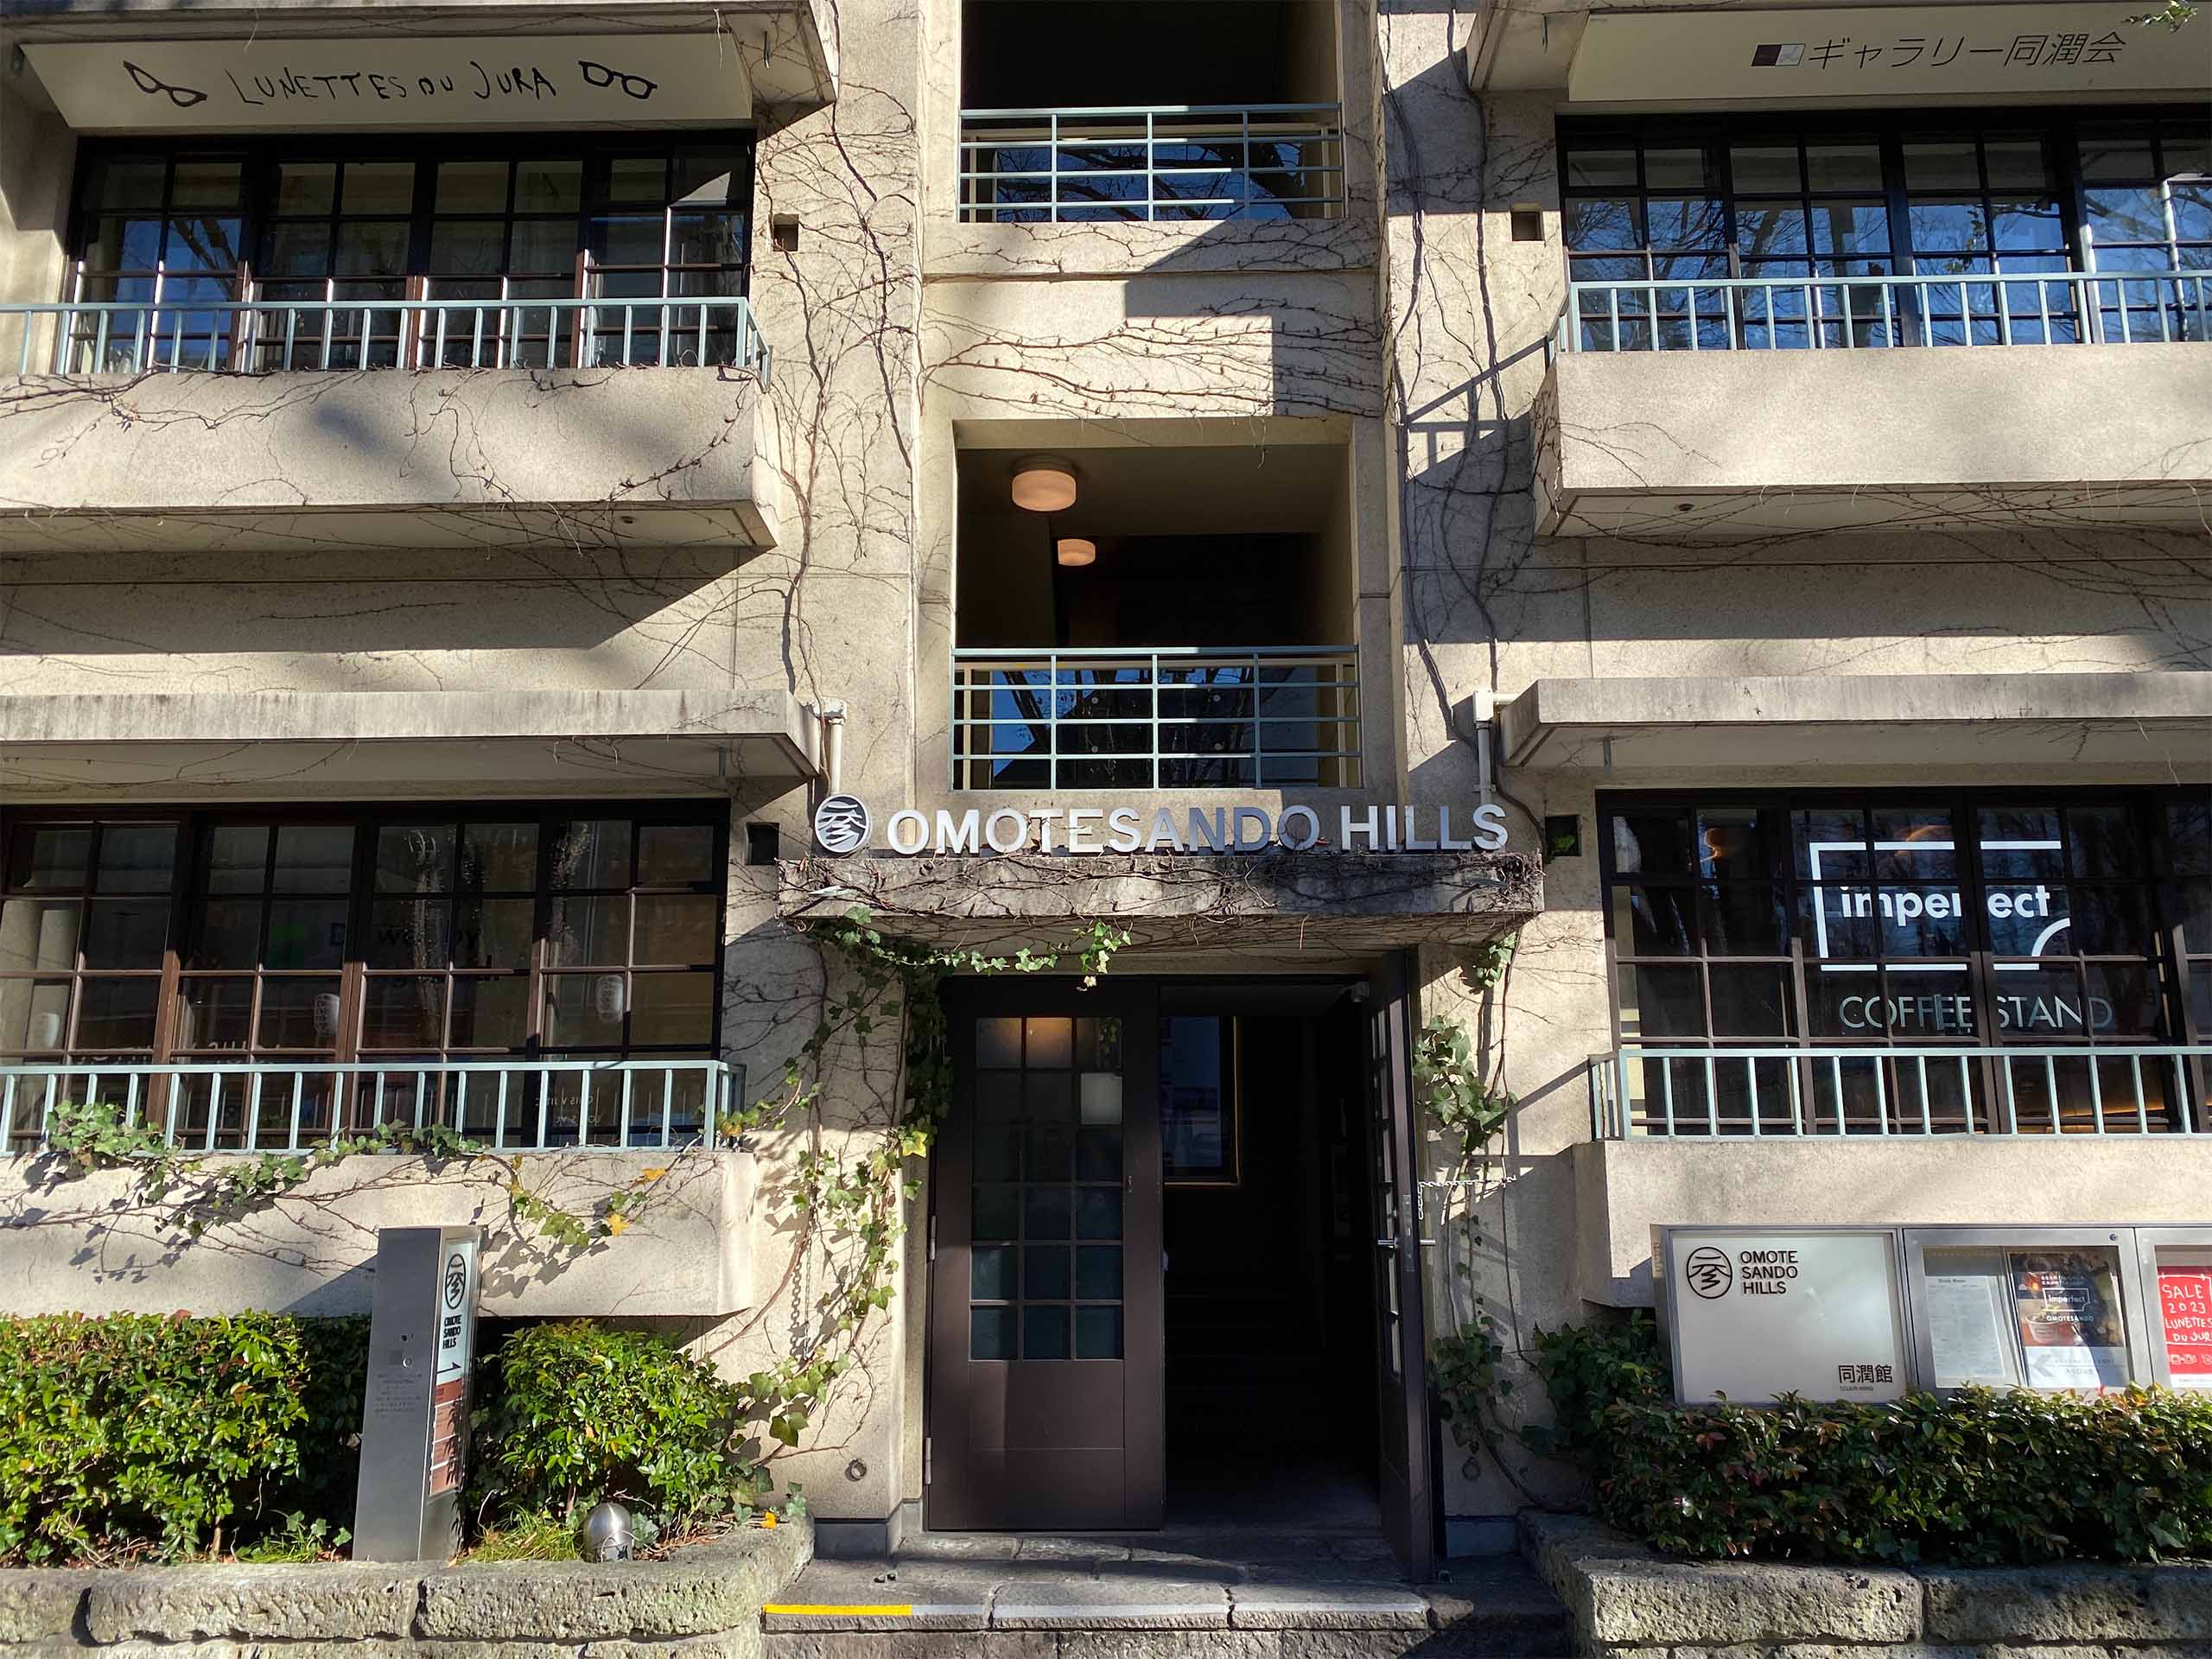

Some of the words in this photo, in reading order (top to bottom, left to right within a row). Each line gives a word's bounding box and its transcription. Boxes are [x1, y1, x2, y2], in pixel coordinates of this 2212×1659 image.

[1808, 31, 2126, 70] ギャラリー同潤会
[223, 67, 408, 105] LUNETTES
[469, 60, 556, 100] JURA
[887, 805, 1321, 855] OMOTESANDO
[1340, 804, 1508, 853] HILLS
[1840, 886, 2051, 926] imperect
[1839, 995, 1974, 1030] COFFEE
[1996, 995, 2113, 1028] STAND
[1740, 1250, 1799, 1263] OMOTE
[1741, 1266, 1799, 1279] SANDO
[1743, 1281, 1787, 1294] HILLS
[2162, 1284, 2204, 1300] SALE
[2167, 1301, 2206, 1314] 2023
[444, 1314, 462, 1327] OMOTE
[443, 1325, 461, 1338] SANDO
[442, 1338, 457, 1349] HILLS
[1838, 1364, 1893, 1383] 同潤館
